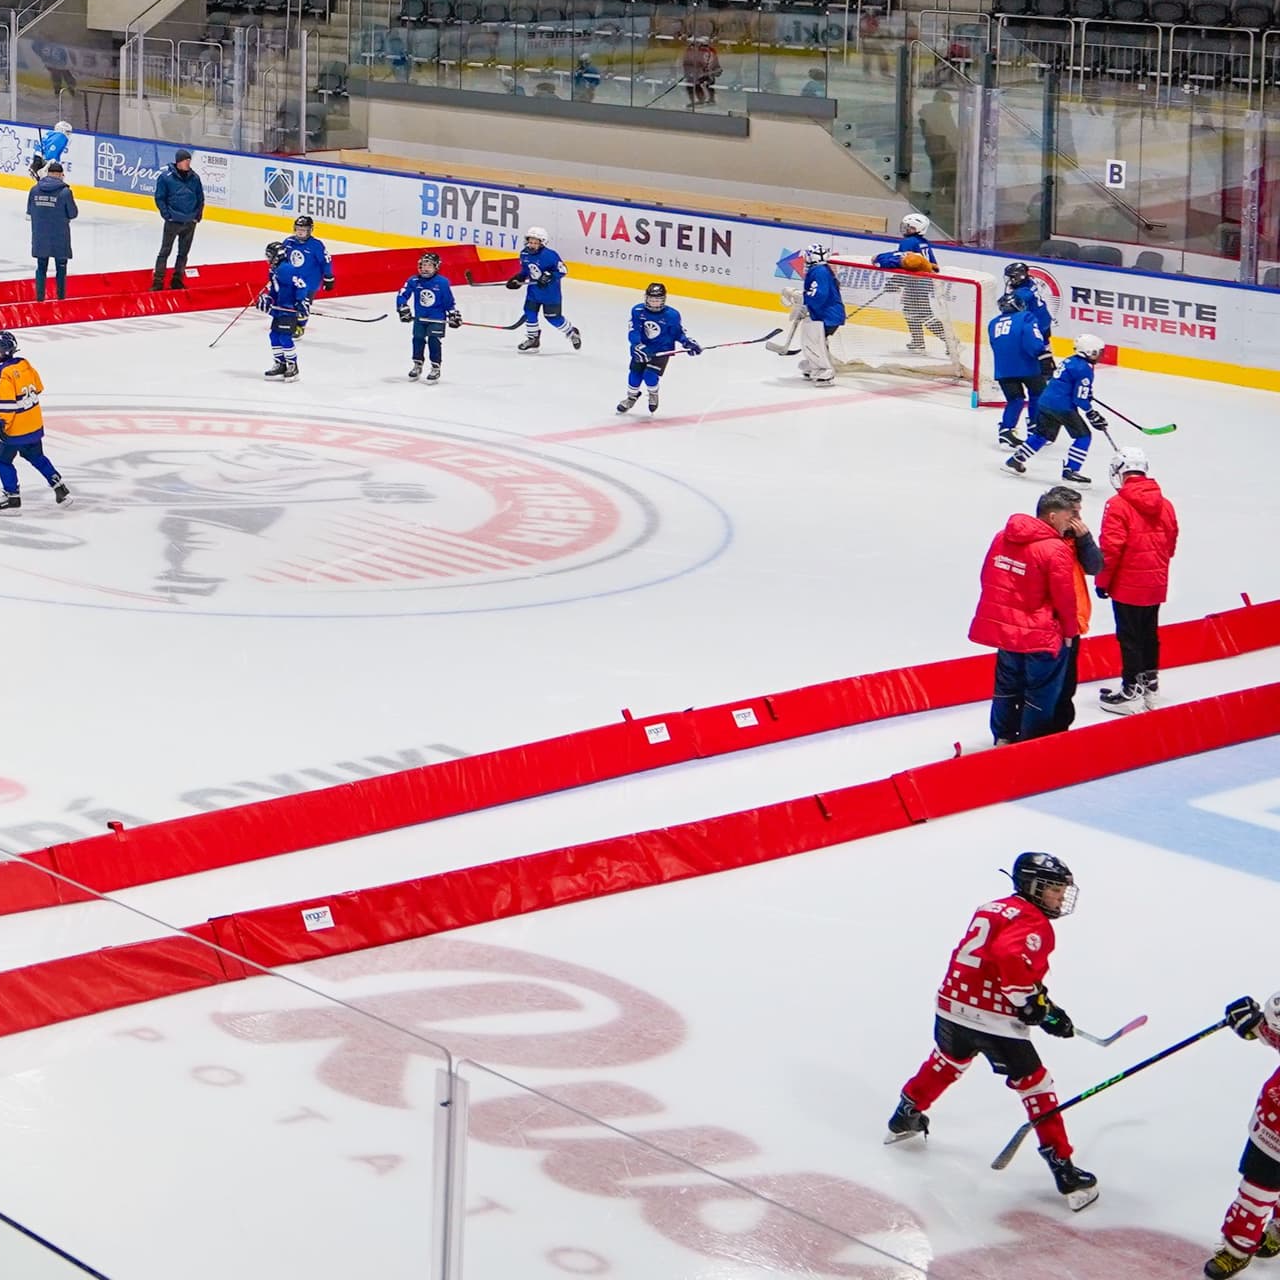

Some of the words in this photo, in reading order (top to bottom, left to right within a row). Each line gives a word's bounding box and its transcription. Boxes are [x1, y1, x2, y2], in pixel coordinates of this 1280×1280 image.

[298, 170, 347, 199] METO
[1110, 164, 1123, 184] B
[298, 194, 347, 220] FERRO
[418, 183, 520, 229] BAYER
[421, 221, 519, 250] PROPERTY
[577, 209, 733, 258] VIASTEIN
[585, 246, 663, 268] transforming
[669, 255, 689, 270] the
[695, 263, 732, 276] space
[1070, 285, 1217, 323] REMETE
[994, 319, 1012, 338] 66
[1070, 306, 1113, 325] ICE
[1122, 313, 1217, 341] ARENA
